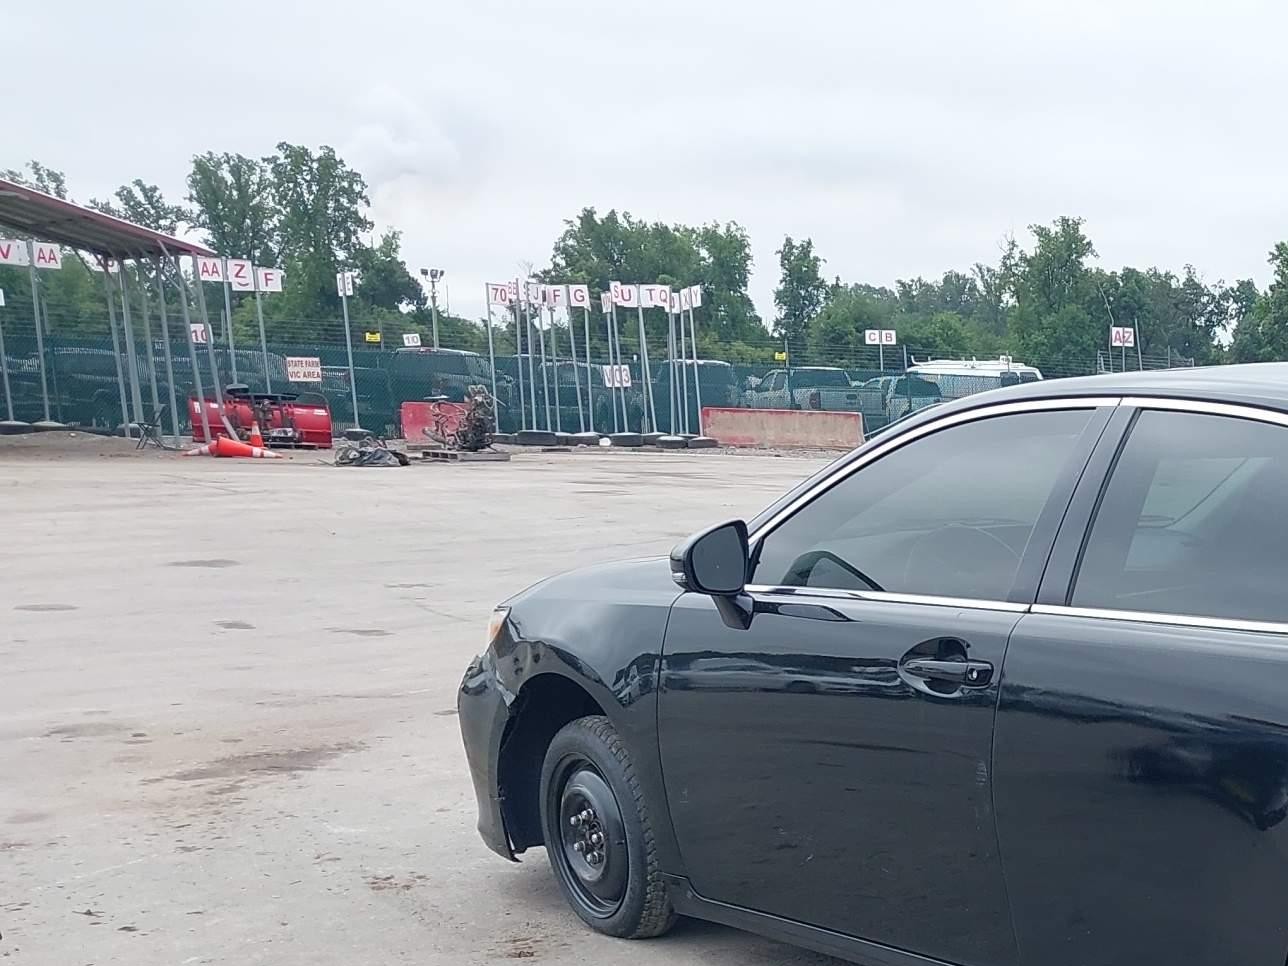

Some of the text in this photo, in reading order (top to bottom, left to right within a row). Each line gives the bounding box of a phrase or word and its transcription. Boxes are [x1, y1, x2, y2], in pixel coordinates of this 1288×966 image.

[37, 247, 58, 265] AA
[201, 262, 220, 278] AA
[234, 263, 248, 279] Z
[264, 272, 274, 287] F
[492, 288, 507, 302] 70
[533, 287, 539, 300] J
[553, 289, 561, 303] F
[574, 289, 585, 302] G
[613, 285, 620, 299] S
[621, 288, 632, 302] U
[645, 288, 655, 301] T
[660, 290, 668, 303] Q
[405, 335, 419, 345] 10
[868, 332, 893, 342] C B
[288, 360, 304, 368] STATE
